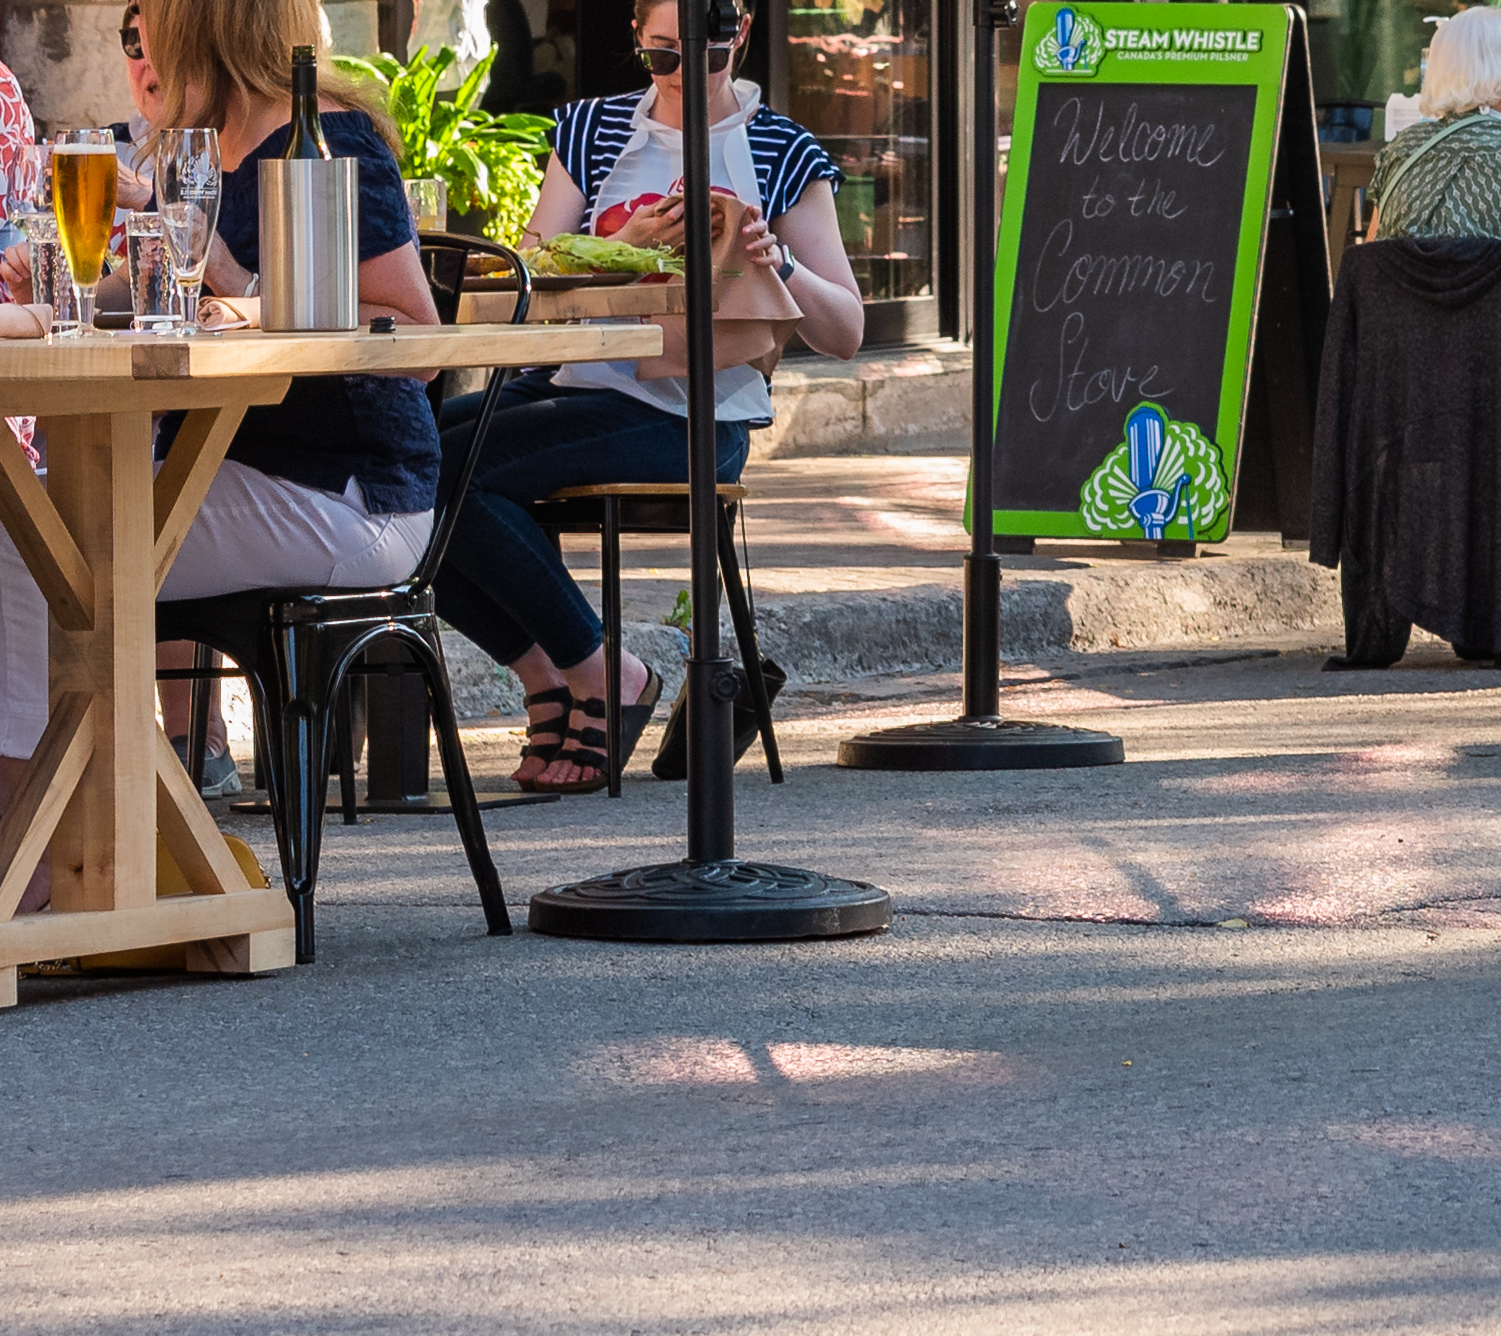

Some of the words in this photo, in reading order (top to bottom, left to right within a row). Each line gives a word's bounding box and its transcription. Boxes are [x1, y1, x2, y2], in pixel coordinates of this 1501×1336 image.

[1104, 28, 1170, 50] STEAM
[1172, 29, 1262, 52] WHISTLE
[1117, 51, 1162, 61] CANADA'S
[1164, 51, 1208, 61] PREMIUM
[1209, 52, 1249, 62] PILSNER
[1053, 96, 1224, 168] Welcome
[1082, 175, 1116, 220] to
[1128, 177, 1188, 220] the
[1032, 218, 1221, 313] Common
[1029, 311, 1175, 423] Stove
